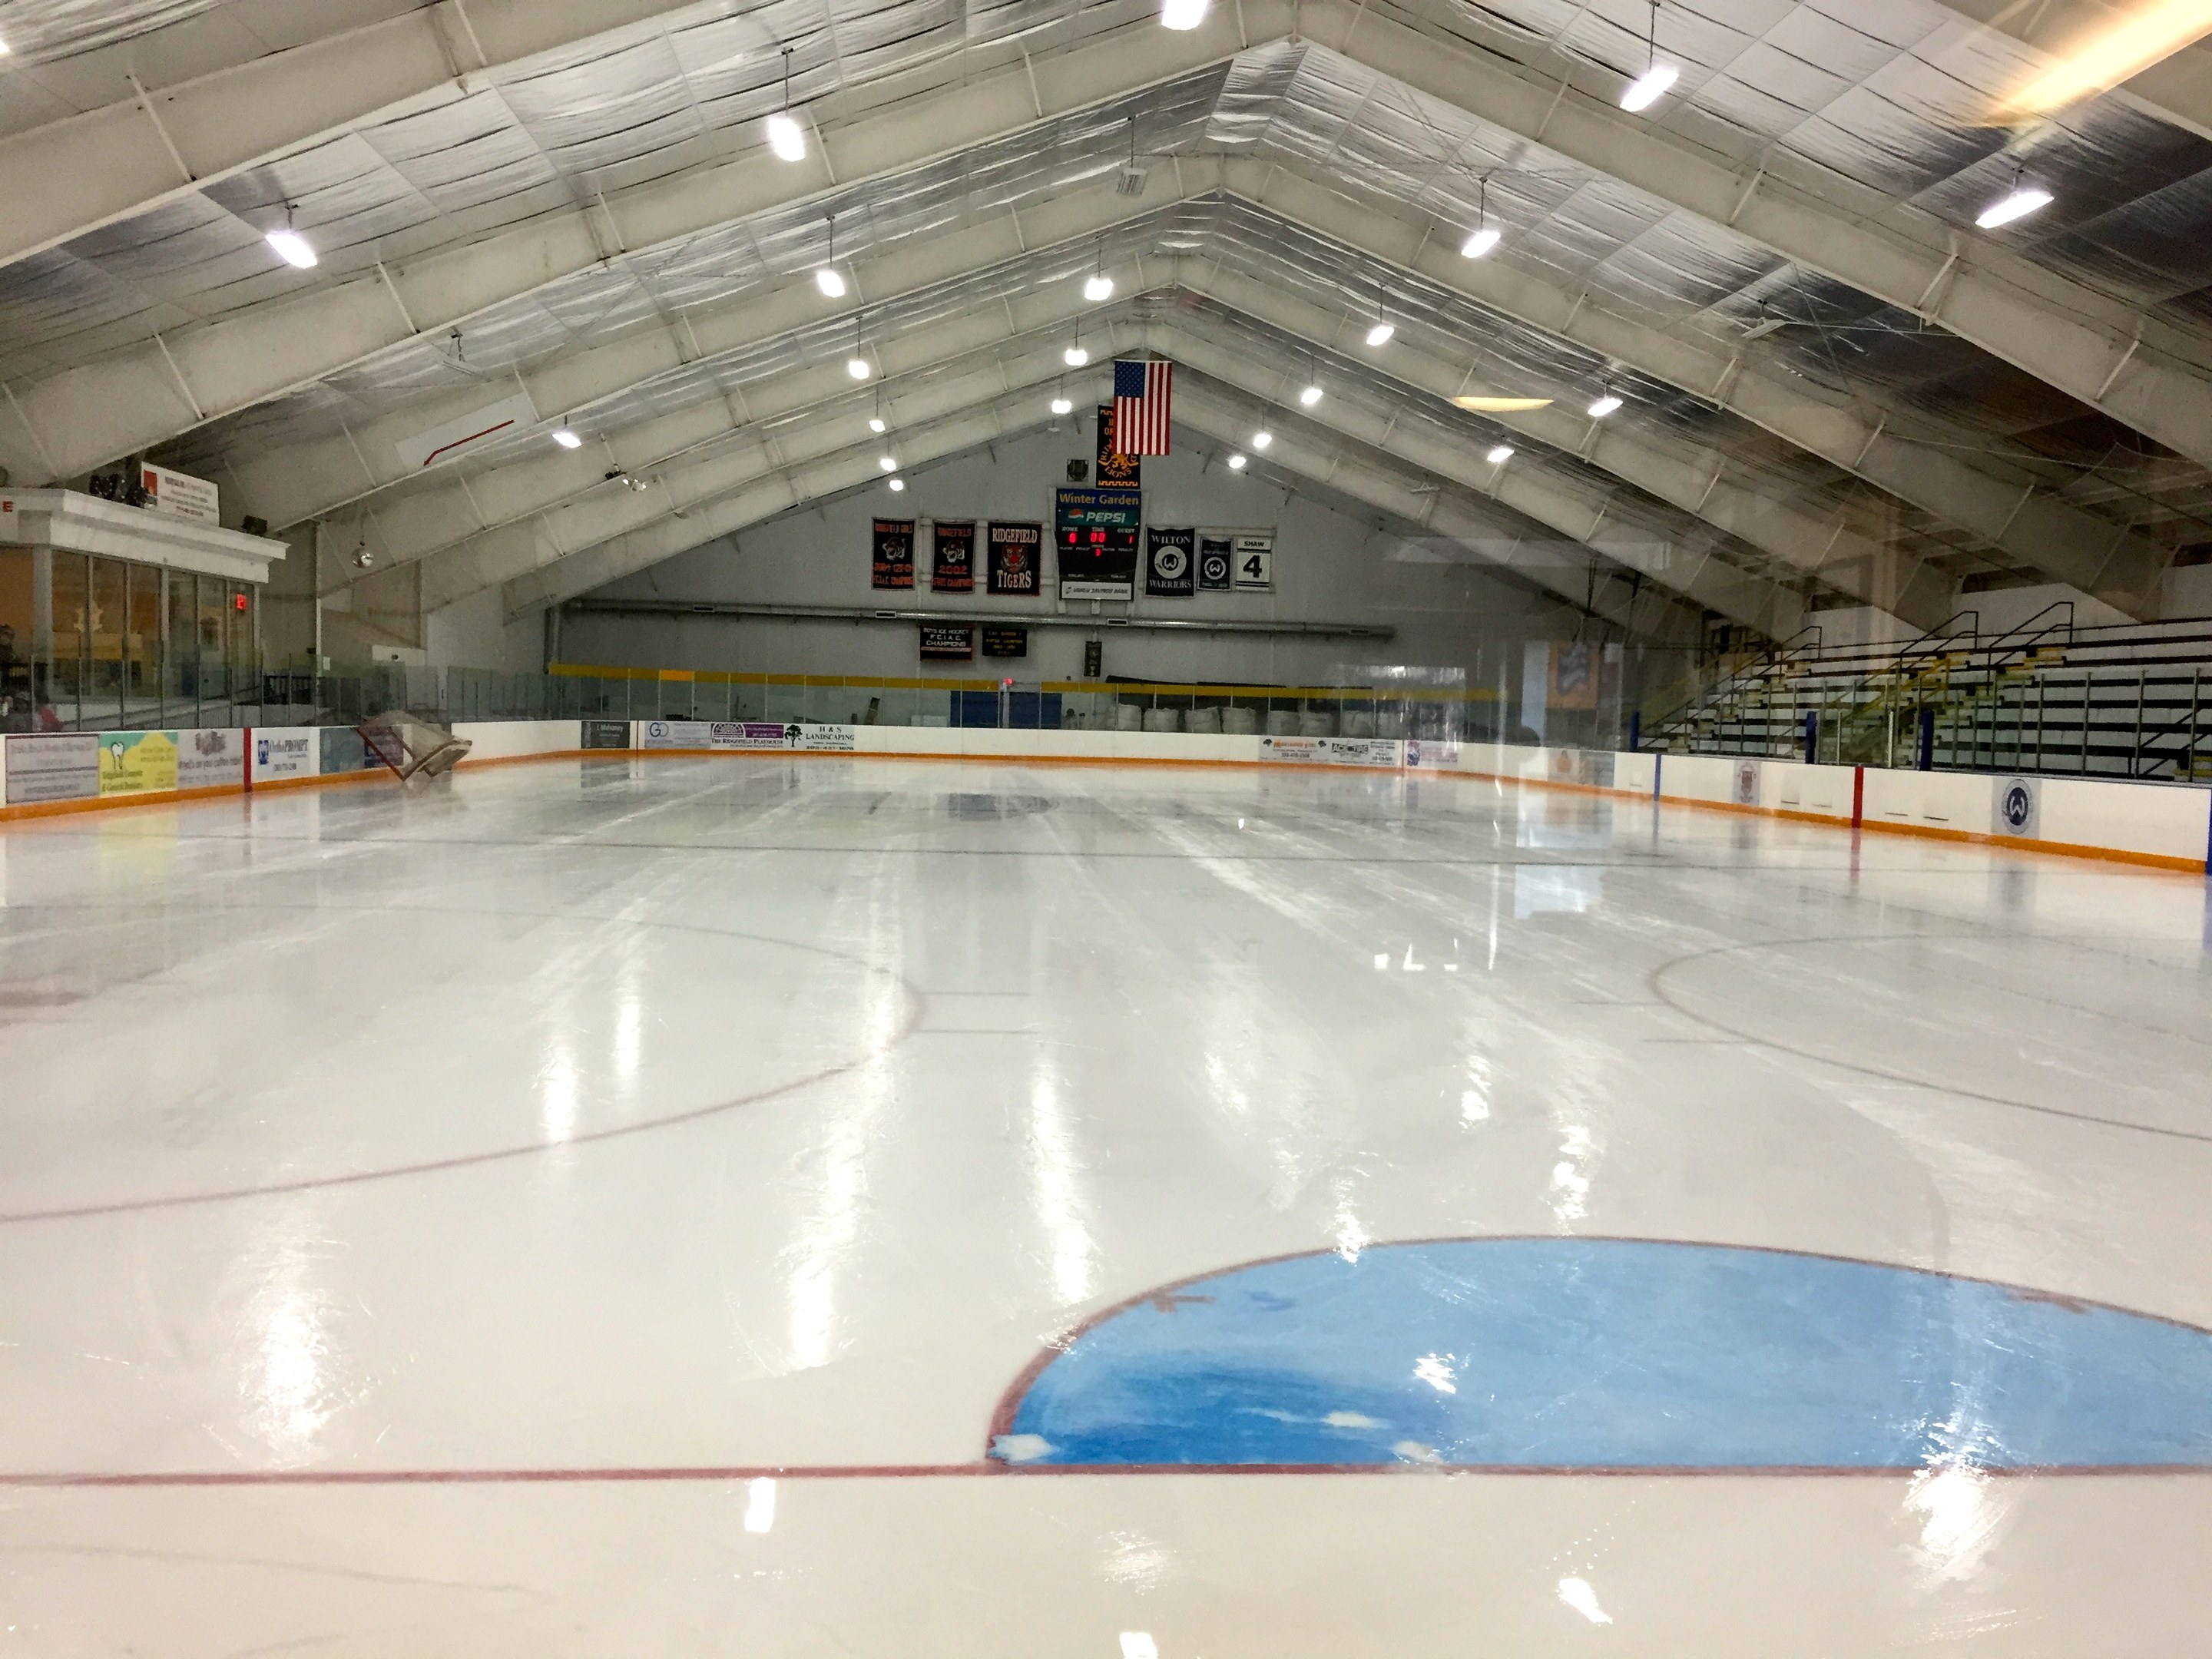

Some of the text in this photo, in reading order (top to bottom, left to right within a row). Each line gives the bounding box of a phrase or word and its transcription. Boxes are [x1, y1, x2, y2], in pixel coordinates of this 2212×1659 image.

[1060, 493, 1138, 505] Winter Garden
[1085, 512, 1126, 523] PEPSI
[992, 528, 1037, 543] RIDGEFIELD
[1151, 535, 1190, 544] WILTON
[1243, 555, 1262, 578] 4
[996, 571, 1031, 588] TIGERS
[1149, 579, 1191, 588] WARRIORS
